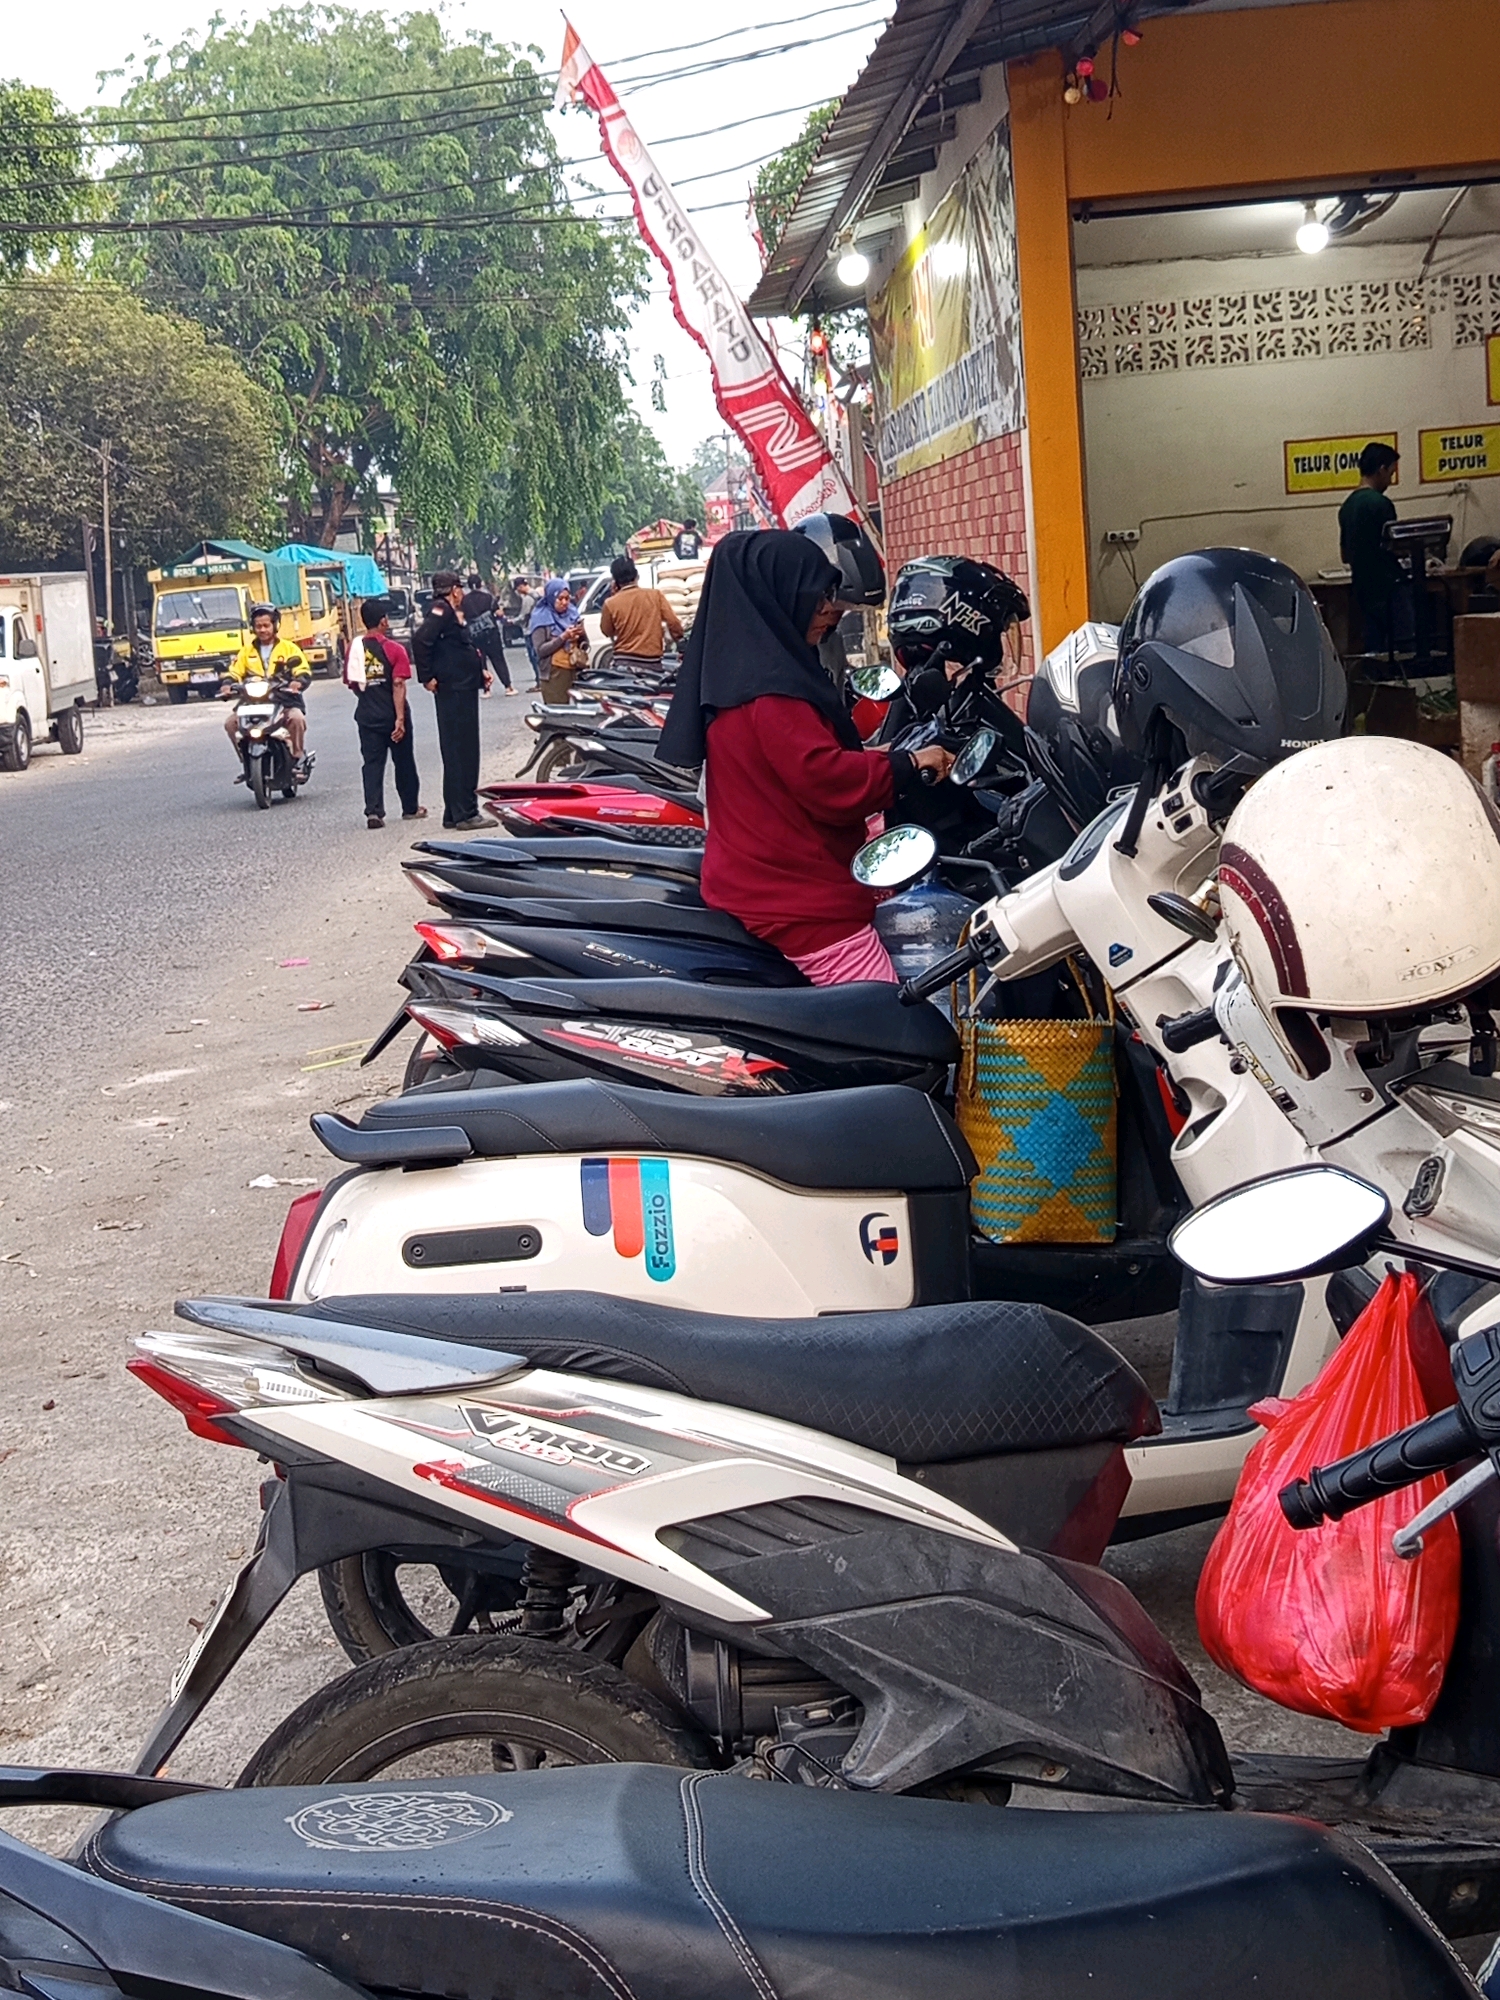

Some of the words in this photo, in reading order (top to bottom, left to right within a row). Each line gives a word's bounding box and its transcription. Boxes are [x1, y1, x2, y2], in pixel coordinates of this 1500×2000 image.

[1440, 434, 1484, 451] TELUR
[1293, 454, 1331, 474] TELUR
[1334, 452, 1362, 474] (OM
[1438, 454, 1487, 472] PUYUH
[938, 590, 991, 636] NHK
[648, 1193, 670, 1269] Fazzio
[462, 1405, 648, 1472] VARIO
